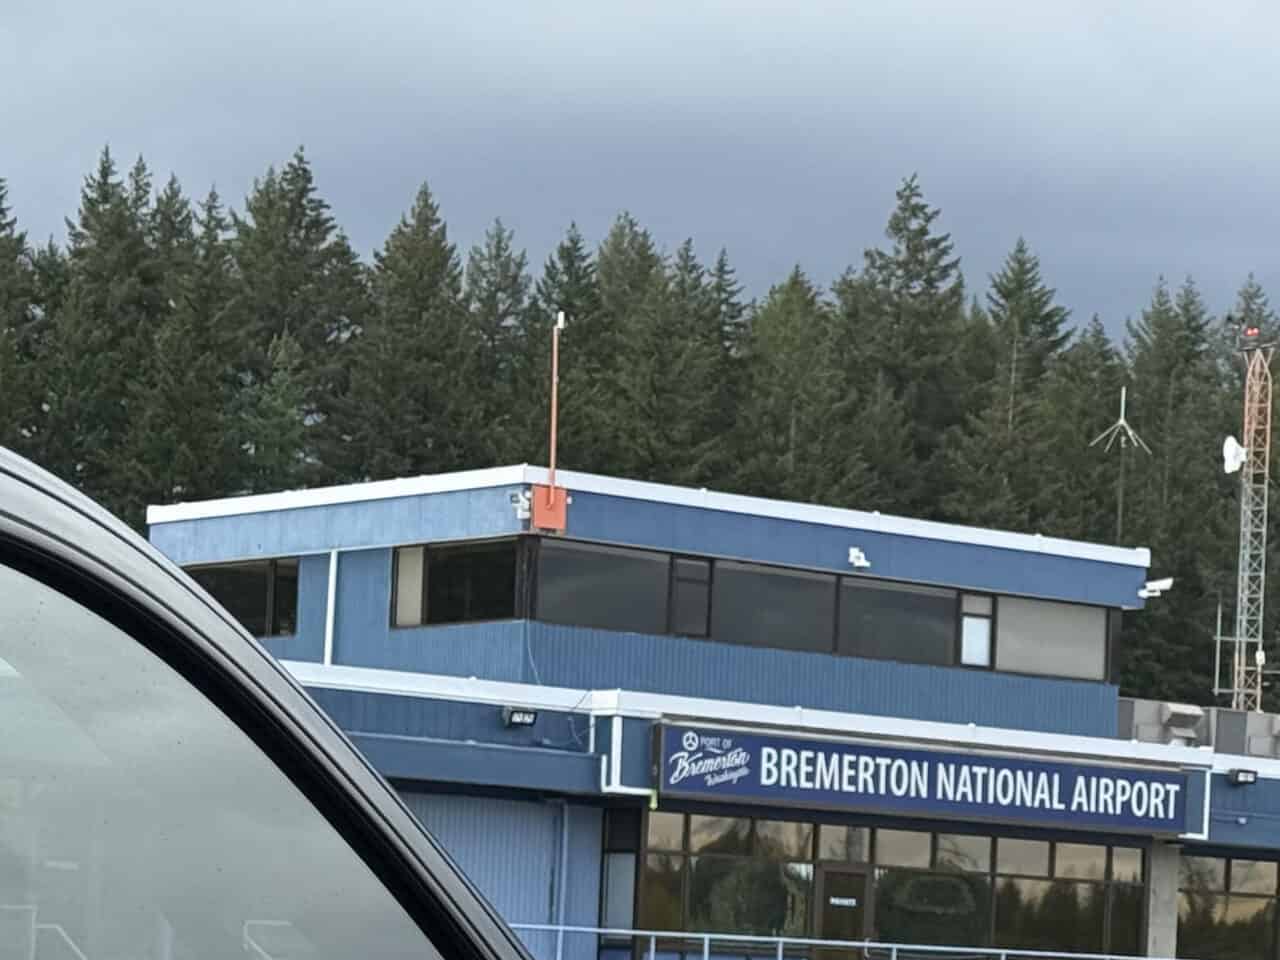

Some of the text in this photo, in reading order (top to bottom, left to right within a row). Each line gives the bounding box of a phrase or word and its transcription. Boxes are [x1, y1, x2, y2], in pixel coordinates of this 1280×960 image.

[669, 747, 751, 785] Bremerton
[760, 746, 1180, 820] BREMERTON NATIONAL AIRPORT
